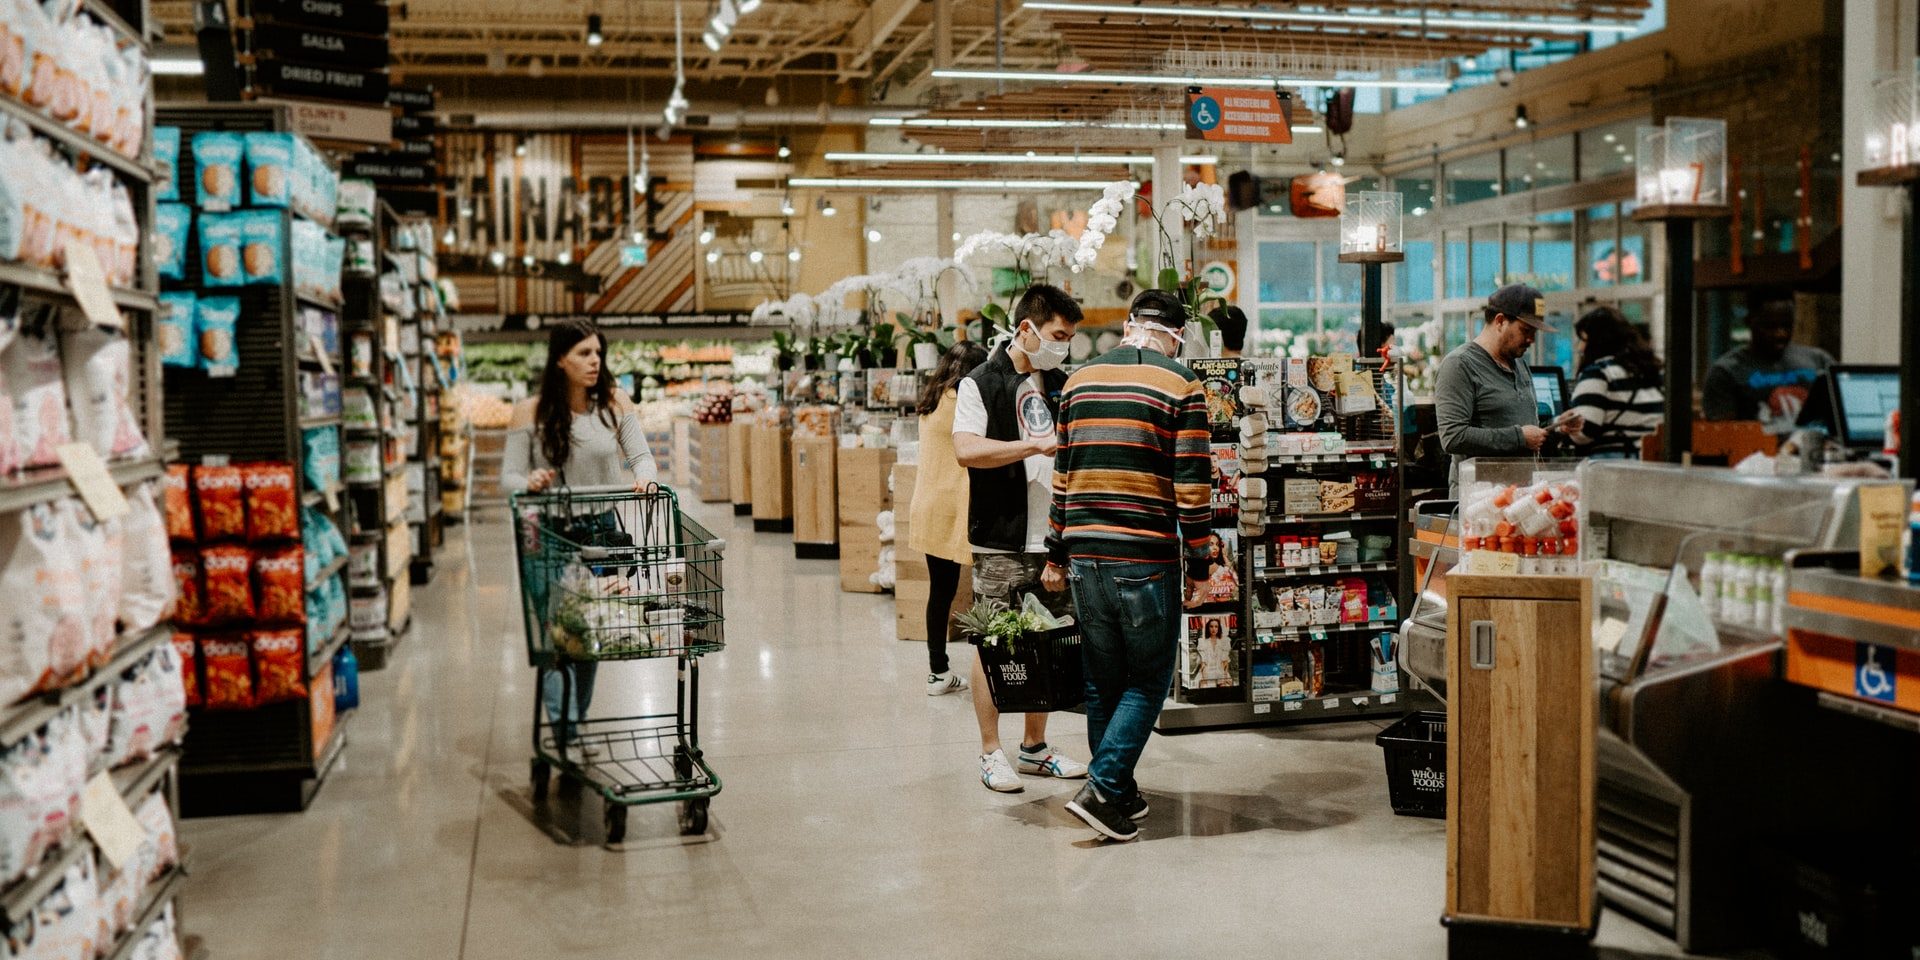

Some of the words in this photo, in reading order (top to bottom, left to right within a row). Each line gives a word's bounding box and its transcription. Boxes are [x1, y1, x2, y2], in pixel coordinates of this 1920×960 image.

[211, 2, 225, 23] 4
[302, 1, 343, 17] CHIPS
[302, 33, 344, 50] SALSA
[281, 66, 324, 83] DRIED
[326, 69, 364, 87] FRUIT
[300, 106, 347, 121] CLINT'S
[355, 163, 390, 176] CEREAL
[399, 165, 424, 178] OATS
[1688, 161, 1705, 203] 7
[1217, 448, 1236, 460] URNAL
[197, 474, 242, 491] dang
[246, 472, 291, 489] dang
[1333, 484, 1348, 495] dang
[1333, 499, 1348, 510] dang
[204, 556, 248, 572] dang
[256, 557, 300, 574] dang
[203, 640, 247, 656] dang
[254, 635, 297, 651] dang
[1000, 664, 1027, 672] WHOLE
[1003, 672, 1027, 681] FOODS
[1411, 769, 1445, 780] WHOLE
[1413, 778, 1444, 788] FOODS
